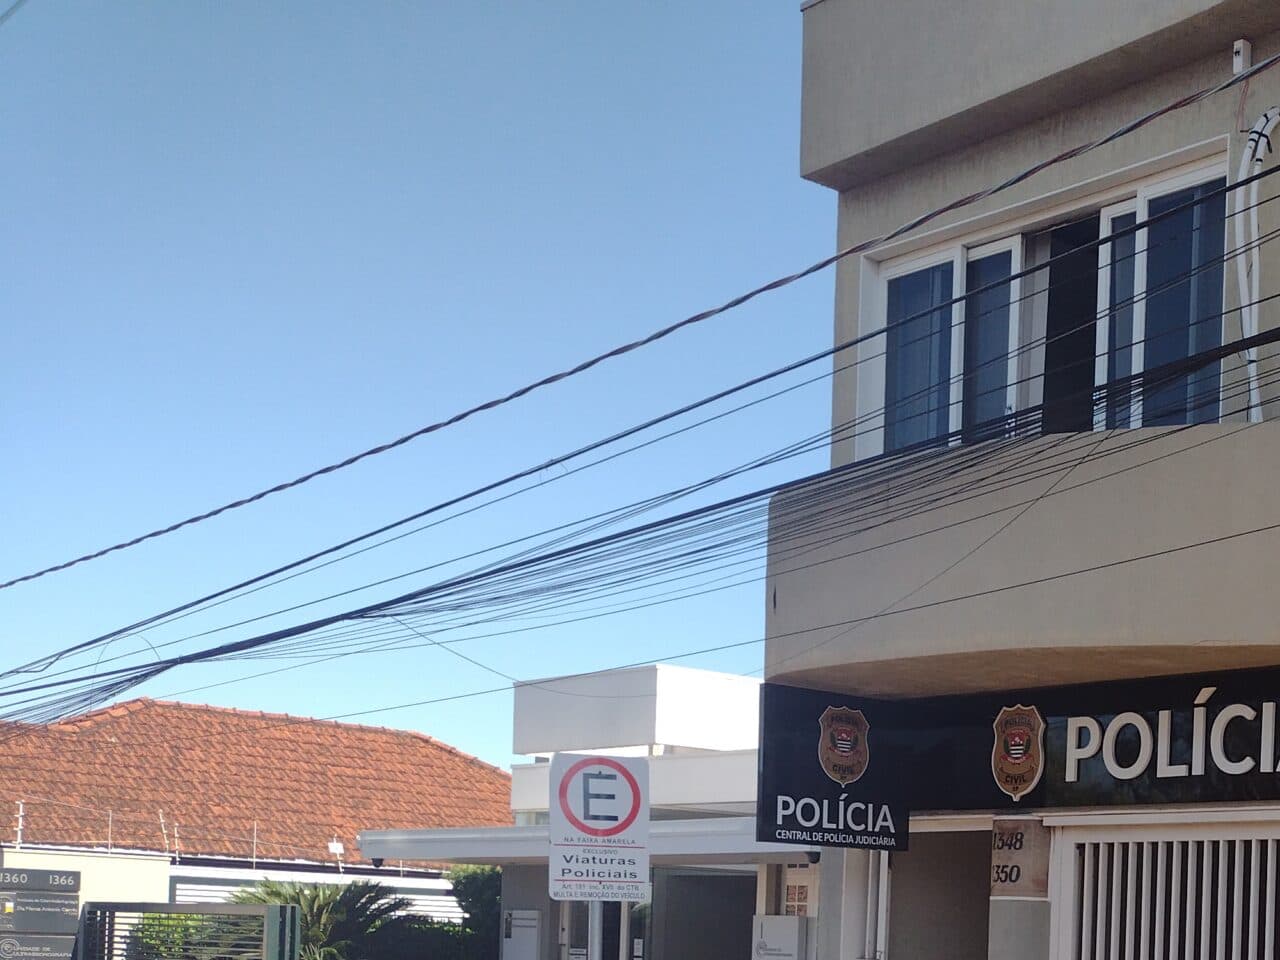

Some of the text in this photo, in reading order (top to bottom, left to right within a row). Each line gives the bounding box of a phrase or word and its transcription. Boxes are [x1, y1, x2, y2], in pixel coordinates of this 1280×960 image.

[1005, 774, 1026, 784] CIVIL
[583, 773, 618, 821] E
[776, 793, 896, 833] POLÍCIA
[776, 829, 896, 847] CENTRAL DE POLÍCIA JUDICIÁRIA
[993, 831, 1024, 851] 1348
[562, 854, 637, 866] Viaturas
[0, 873, 74, 886] 1360 1366
[561, 868, 639, 879] Policiais
[580, 891, 610, 900] REMOÇÃO
[621, 891, 646, 900] VEÍCULO
